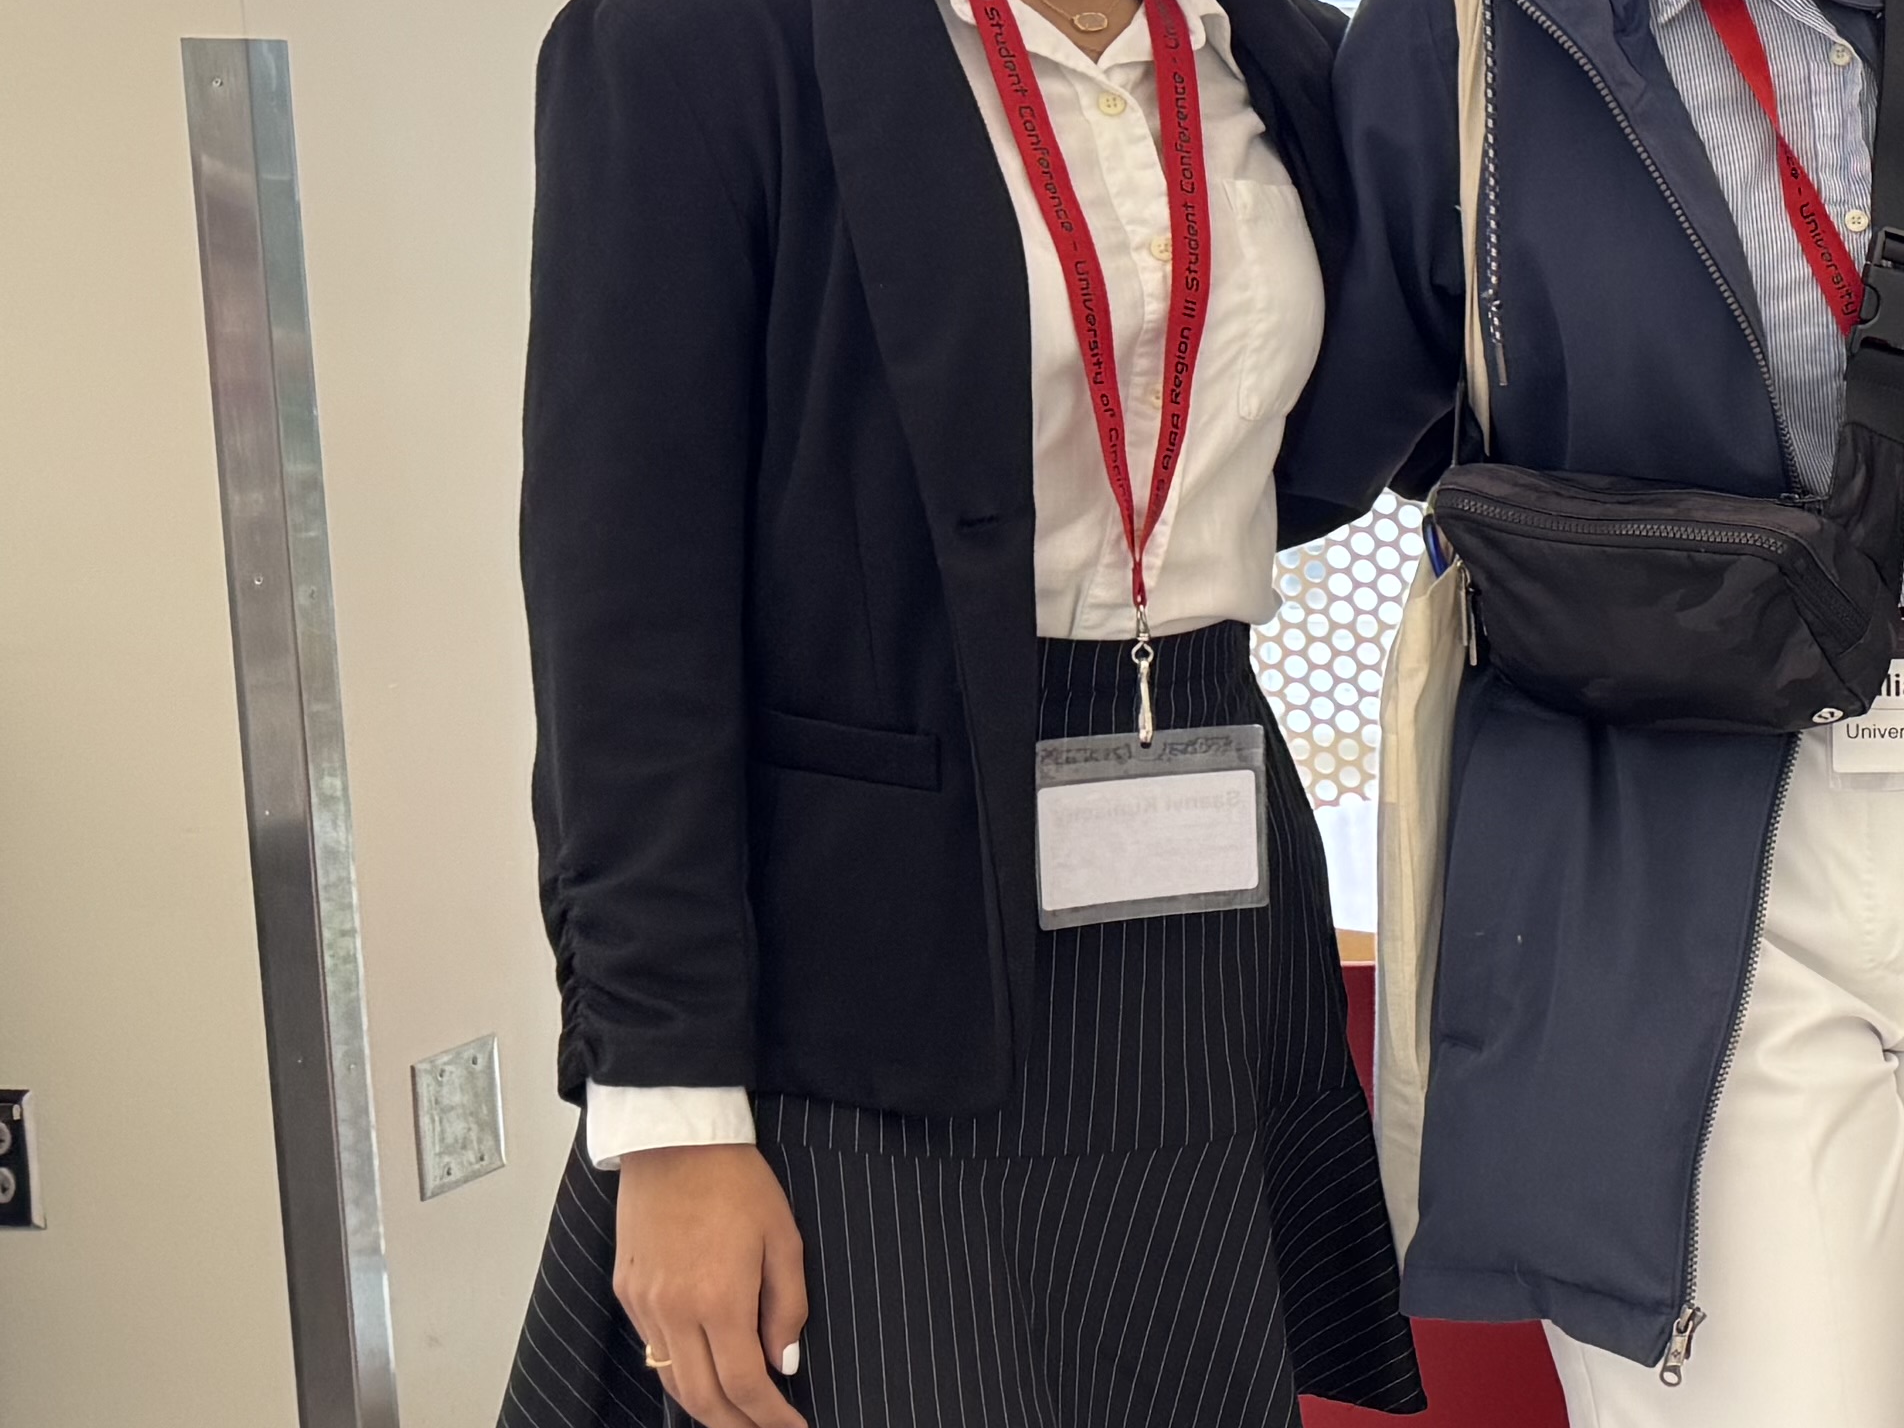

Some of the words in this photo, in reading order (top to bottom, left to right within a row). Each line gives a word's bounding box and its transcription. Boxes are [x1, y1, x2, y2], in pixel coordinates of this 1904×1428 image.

[1174, 71, 1195, 196] Conference
[985, 5, 1028, 97] Student
[1017, 104, 1074, 233] Conference
[1074, 259, 1105, 386] University
[1100, 393, 1115, 419] of
[1184, 201, 1200, 291] Student
[1799, 202, 1858, 319] University
[1182, 300, 1197, 318] III
[1170, 325, 1190, 406] Region
[1161, 413, 1181, 471] AIAA
